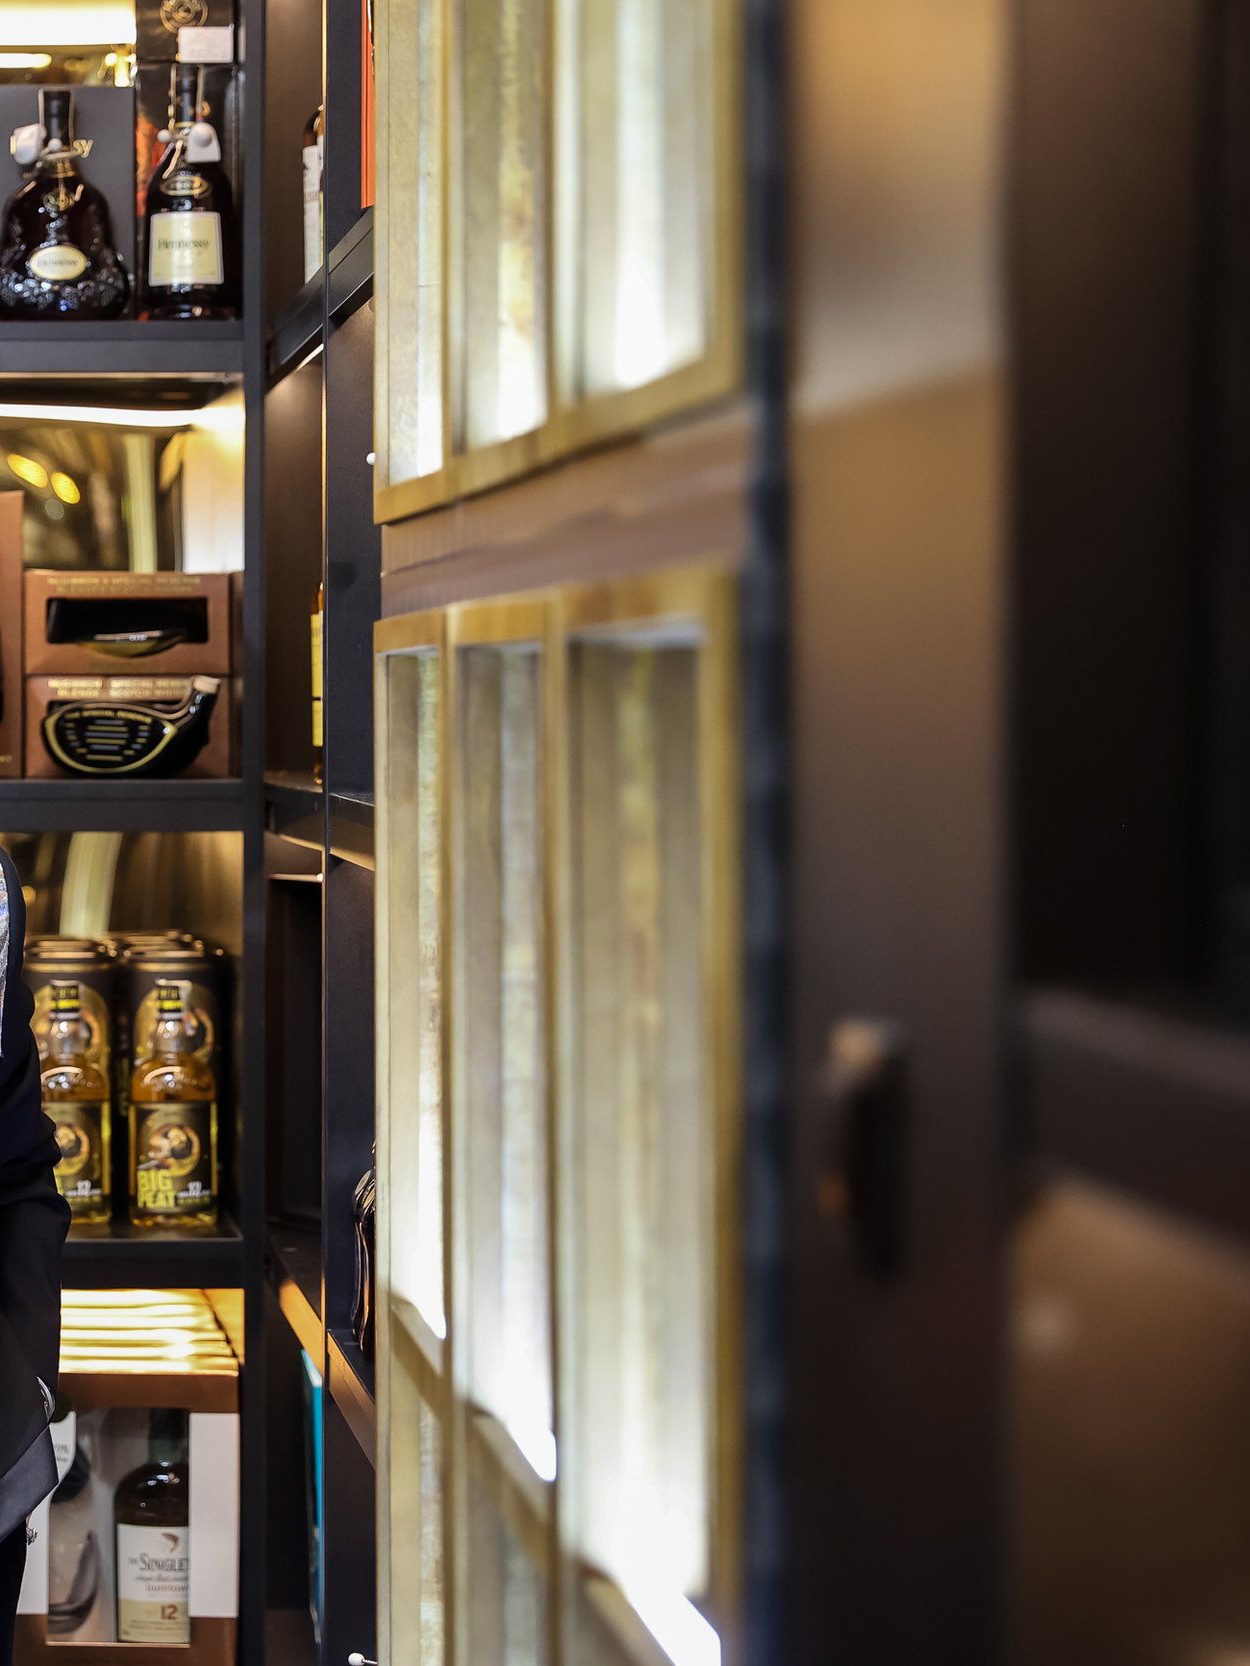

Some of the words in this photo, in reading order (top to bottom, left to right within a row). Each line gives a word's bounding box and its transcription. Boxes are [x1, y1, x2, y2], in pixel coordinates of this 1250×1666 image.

[137, 1169, 172, 1190] BIG
[137, 1189, 176, 1208] PEAT
[160, 1604, 179, 1620] 12
